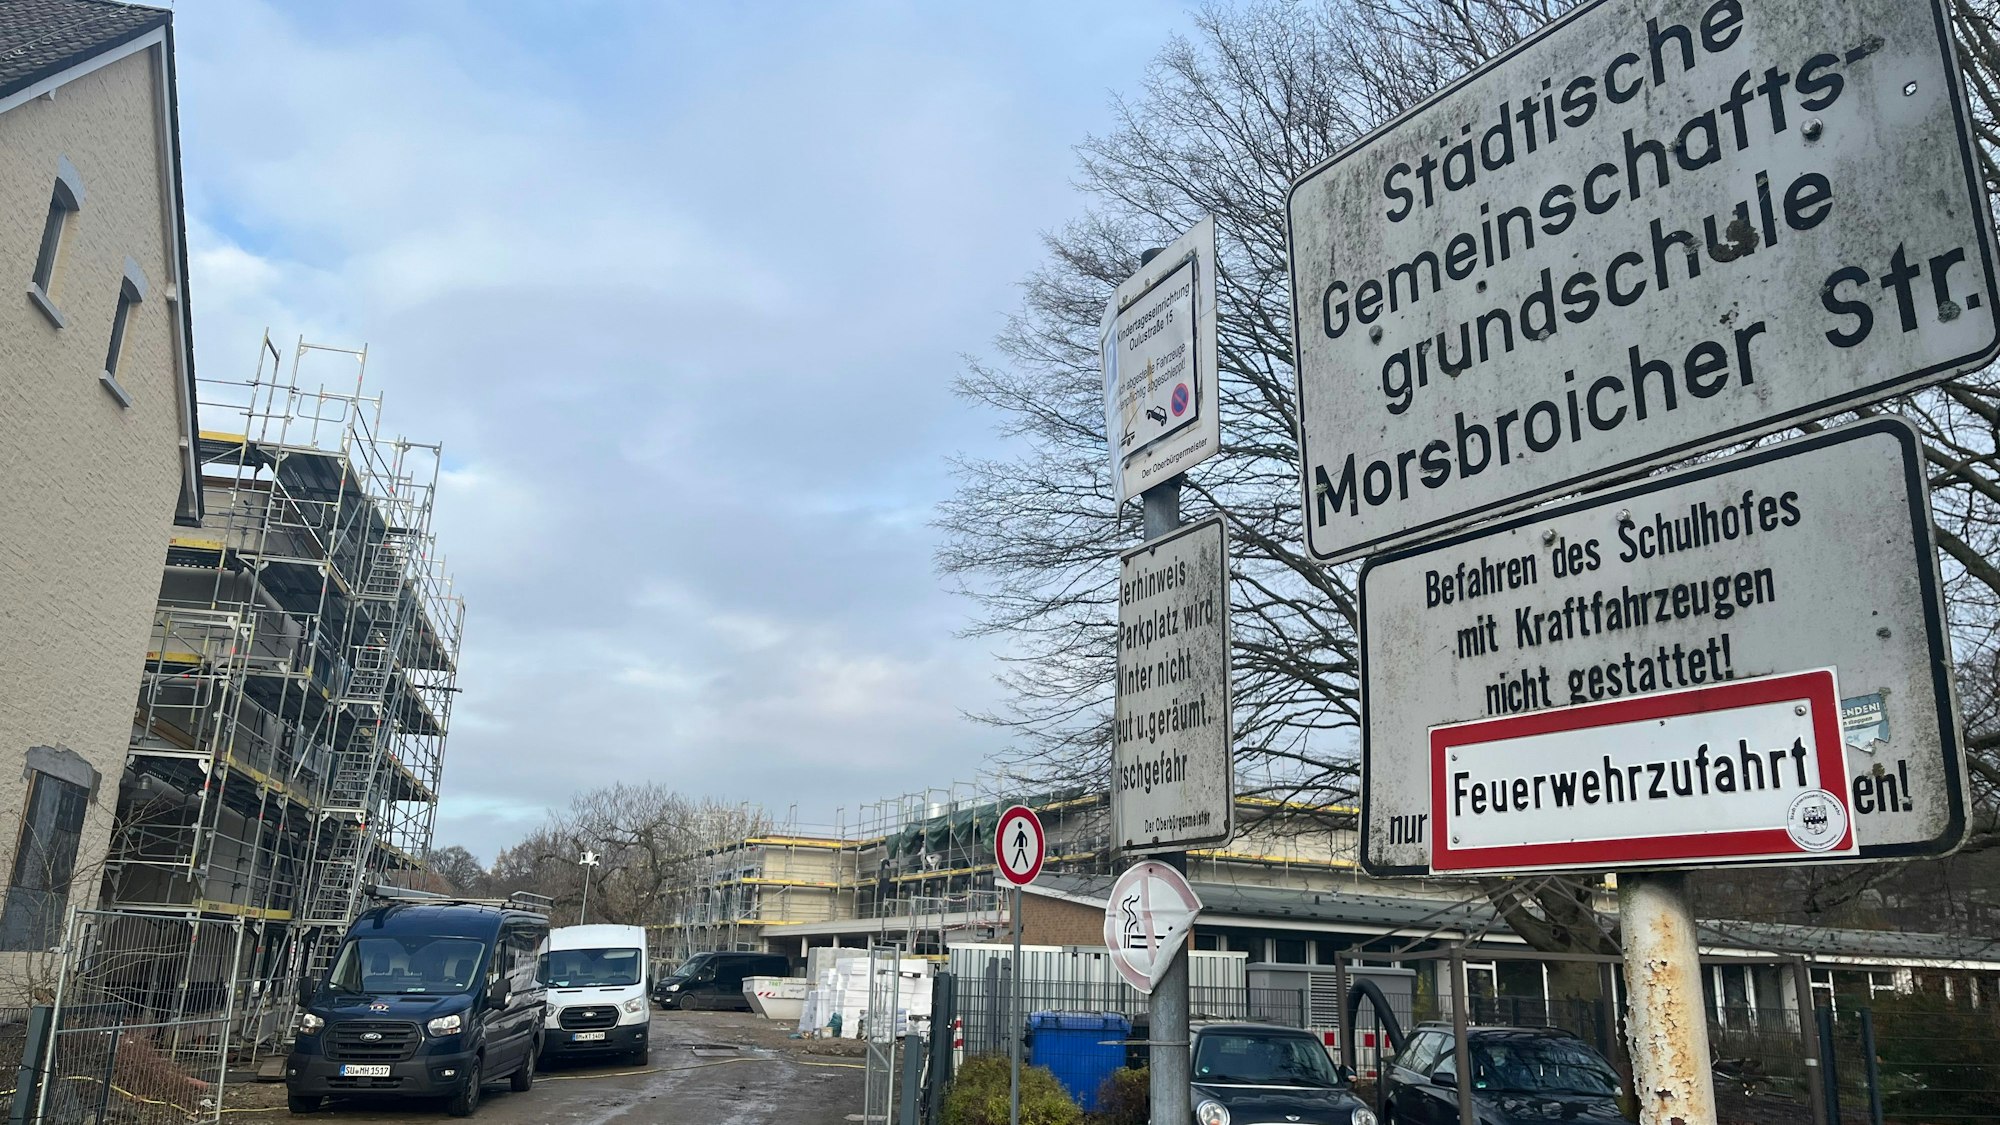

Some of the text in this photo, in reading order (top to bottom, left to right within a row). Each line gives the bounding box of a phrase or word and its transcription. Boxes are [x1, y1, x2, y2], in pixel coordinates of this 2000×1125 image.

[1383, 0, 1744, 222] Städtische
[1322, 35, 1885, 339] Gemeinschafts-
[1381, 170, 1833, 414] grundschule
[1129, 309, 1174, 351] Oulustraße 15
[1156, 343, 1186, 371] Fahrzeuge
[1147, 357, 1186, 393] abgeschleppt!
[1315, 242, 1979, 527] Morsbroicher Str.
[1141, 438, 1207, 479] Der Oberbürgermeister
[1425, 490, 1801, 608] Befahren des Schulhofes
[1119, 590, 1213, 652] Parkplatz wird
[1457, 567, 1775, 658] mit Kraftfahrzeugen
[1157, 647, 1192, 687] nicht
[1486, 633, 1735, 715] nicht gestattet!
[1453, 737, 1811, 818] Feuerwehrzufahrt
[1144, 811, 1210, 833] Der Oberbürgermeister
[1390, 814, 1428, 845] nur
[345, 1066, 389, 1075] SU MH 1517
